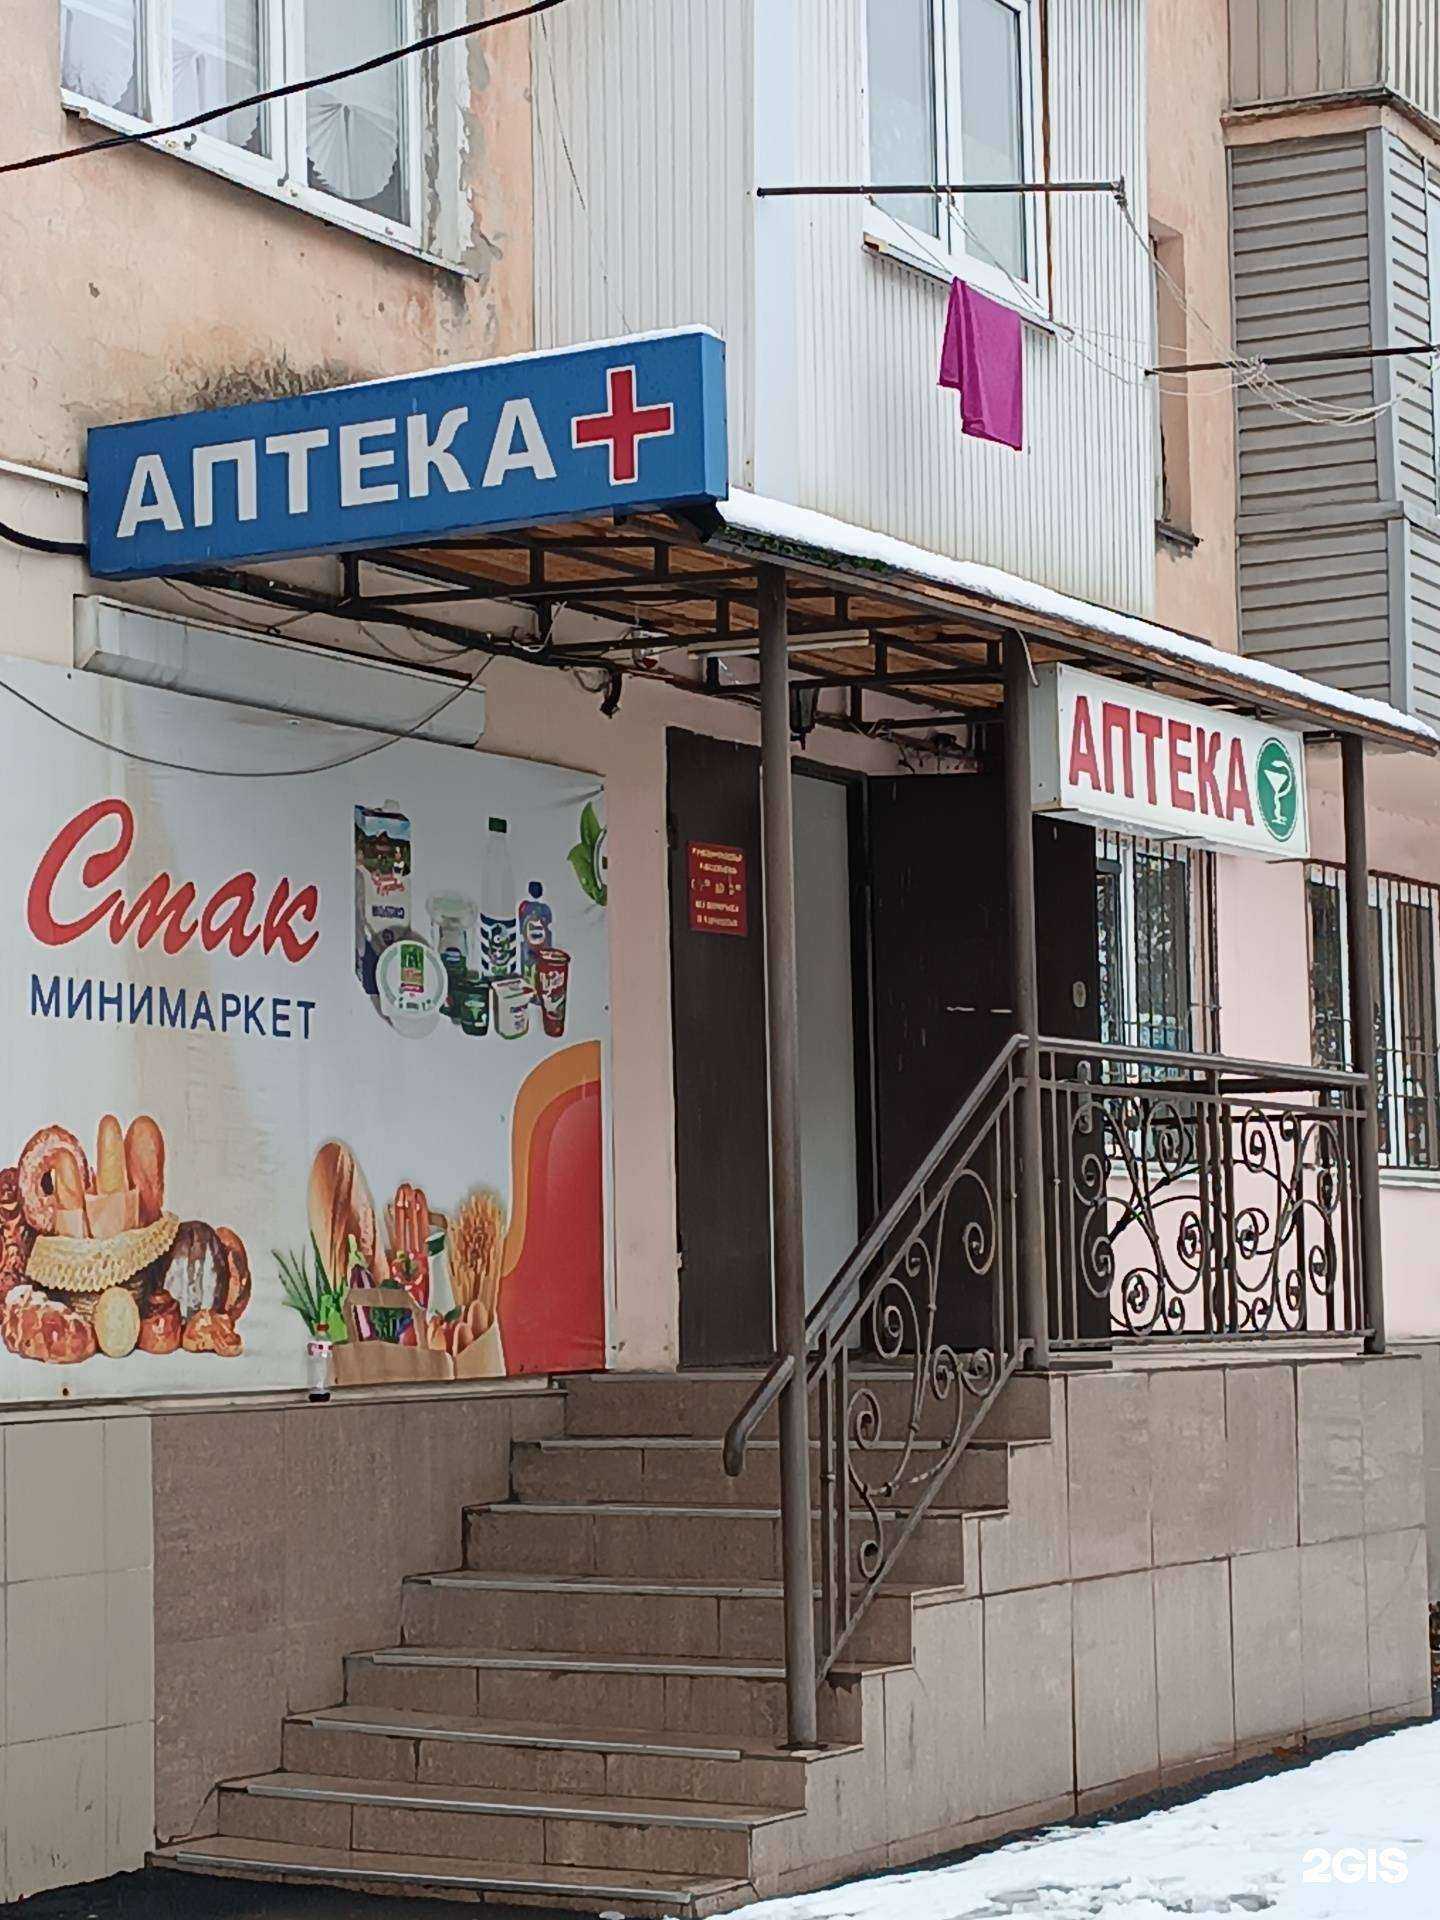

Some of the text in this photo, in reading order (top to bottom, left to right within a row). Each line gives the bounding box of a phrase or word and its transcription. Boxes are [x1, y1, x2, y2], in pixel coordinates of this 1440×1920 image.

[116, 398, 556, 538] АПТЕКА
[1069, 696, 1255, 826] АПТЕКА
[27, 798, 320, 963] Смак
[31, 973, 316, 1040] МИНИМАРКЕТ
